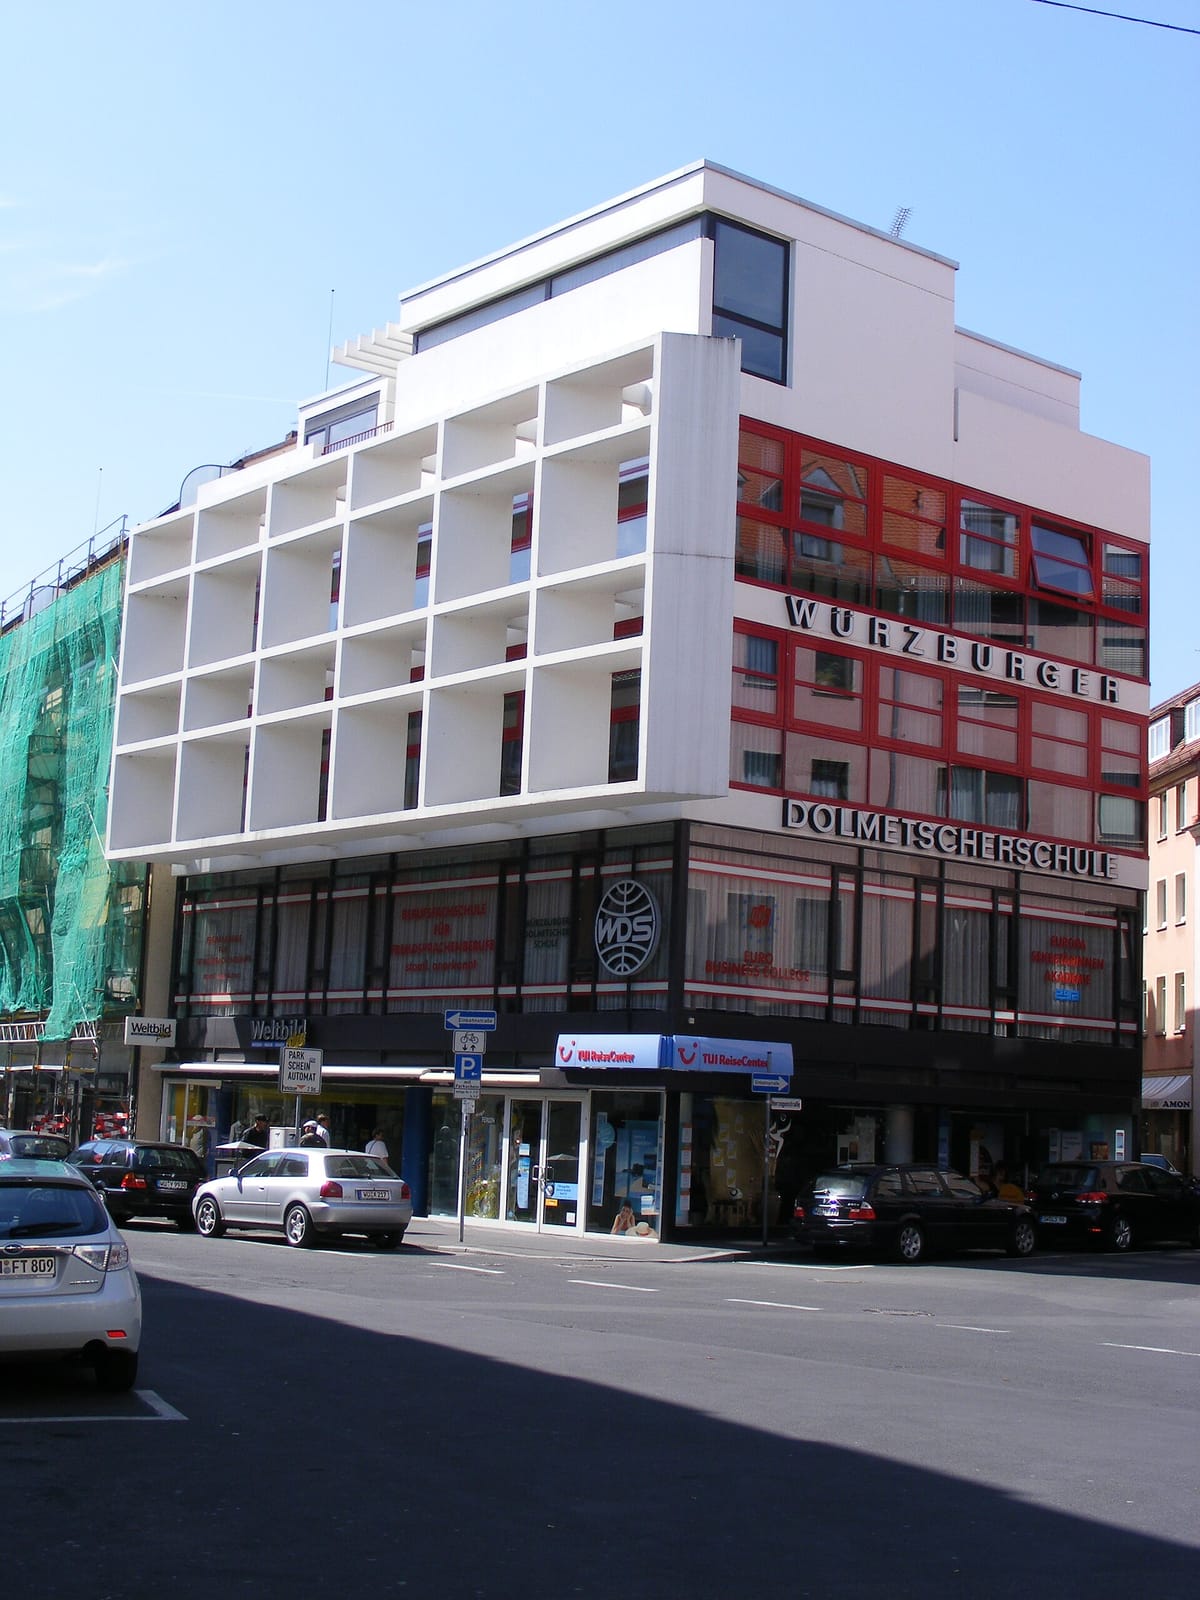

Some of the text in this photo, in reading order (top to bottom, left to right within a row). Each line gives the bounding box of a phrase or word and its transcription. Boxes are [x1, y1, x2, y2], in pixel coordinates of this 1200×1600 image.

[785, 596, 1120, 703] WÜRZBURGER
[782, 799, 1118, 880] DOLMETSCHERSCHULE
[598, 915, 653, 943] WDS
[744, 950, 773, 965] EURO
[705, 959, 810, 982] BUSINESS COLLEGE
[131, 1022, 172, 1035] Weltbild
[251, 1019, 307, 1042] Weltbild
[288, 1050, 305, 1060] PARK
[578, 1050, 635, 1064] TUI ReiseCenter
[702, 1053, 718, 1064] TUI
[288, 1061, 311, 1071] SCHEIN
[460, 1056, 476, 1078] P
[287, 1072, 316, 1082] AUTOMAT
[1162, 1100, 1190, 1108] AMON
[12, 1259, 54, 1273] FT 809
